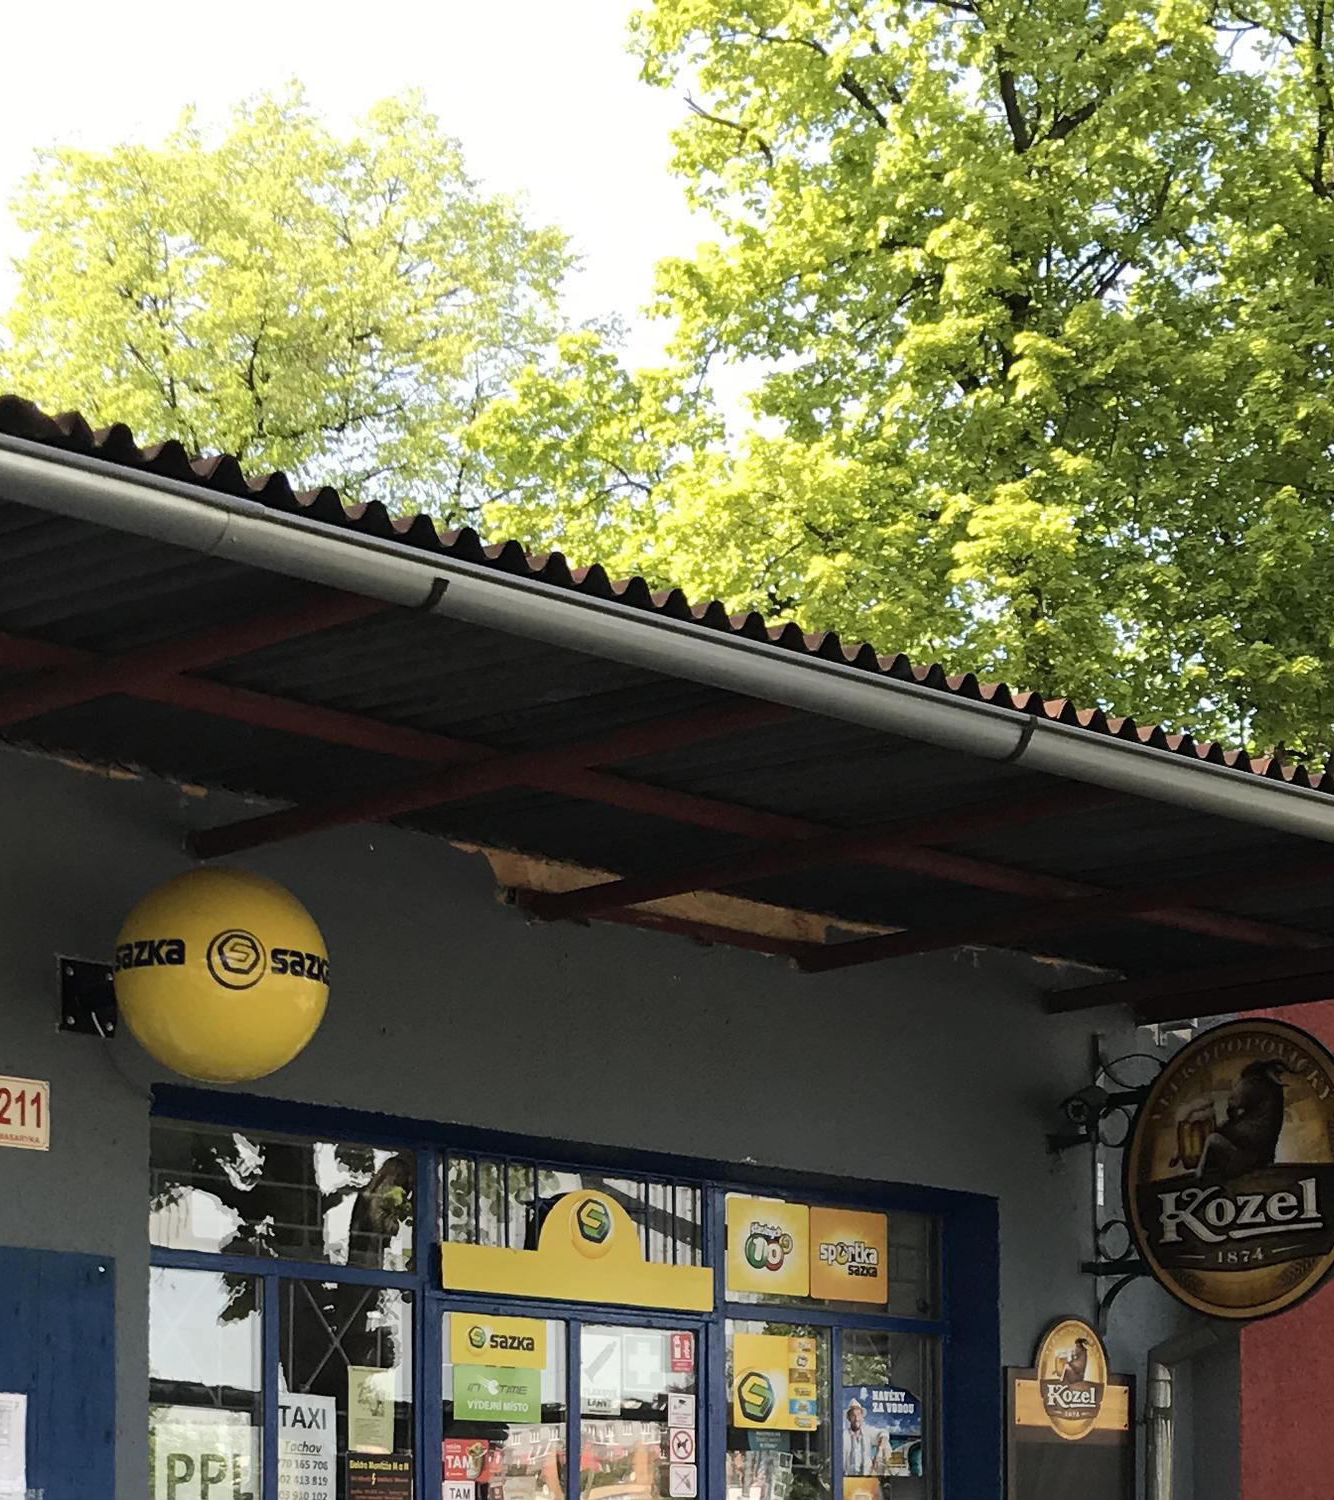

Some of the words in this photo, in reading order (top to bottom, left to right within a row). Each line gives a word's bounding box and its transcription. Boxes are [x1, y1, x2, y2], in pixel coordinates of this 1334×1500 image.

[1157, 1177, 1324, 1245] Kozel
[819, 1241, 879, 1265] sportka
[1216, 1248, 1264, 1264] 1874
[848, 1265, 877, 1278] sazka
[489, 1333, 535, 1352] sazka
[1047, 1384, 1096, 1408] Kozel
[467, 1400, 502, 1411] VÝDEJNÍ
[872, 1402, 883, 1412] ZA
[886, 1402, 914, 1415] VODOU
[278, 1405, 326, 1430] TAXI
[284, 1440, 322, 1454] Tachov
[446, 1456, 473, 1469] TAM
[166, 1452, 254, 1500] PPL
[450, 1488, 471, 1500] TAM
